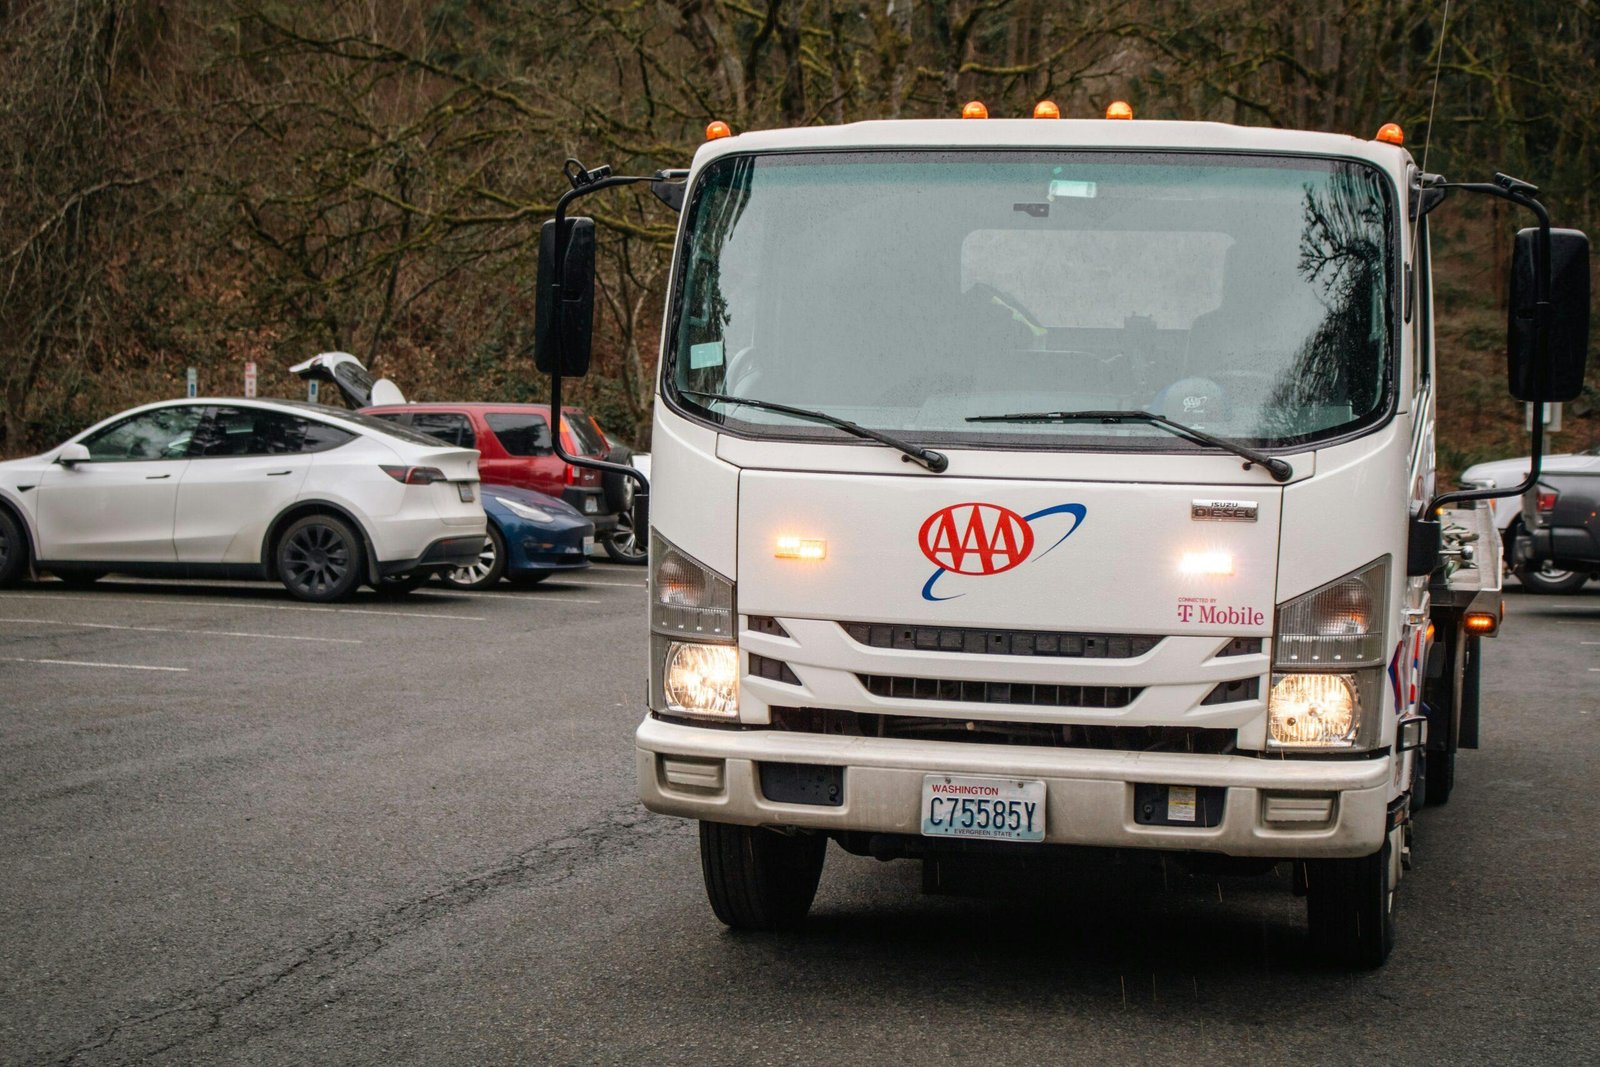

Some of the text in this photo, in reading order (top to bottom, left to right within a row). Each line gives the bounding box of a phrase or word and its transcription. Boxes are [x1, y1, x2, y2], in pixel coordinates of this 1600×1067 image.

[1194, 508, 1255, 518] DIESEL
[925, 503, 1026, 575] AAA
[1177, 604, 1264, 626] T Mobile
[932, 784, 999, 796] WASHINGTON
[930, 797, 1036, 832] C75585Y
[954, 828, 991, 836] EVERGREEN
